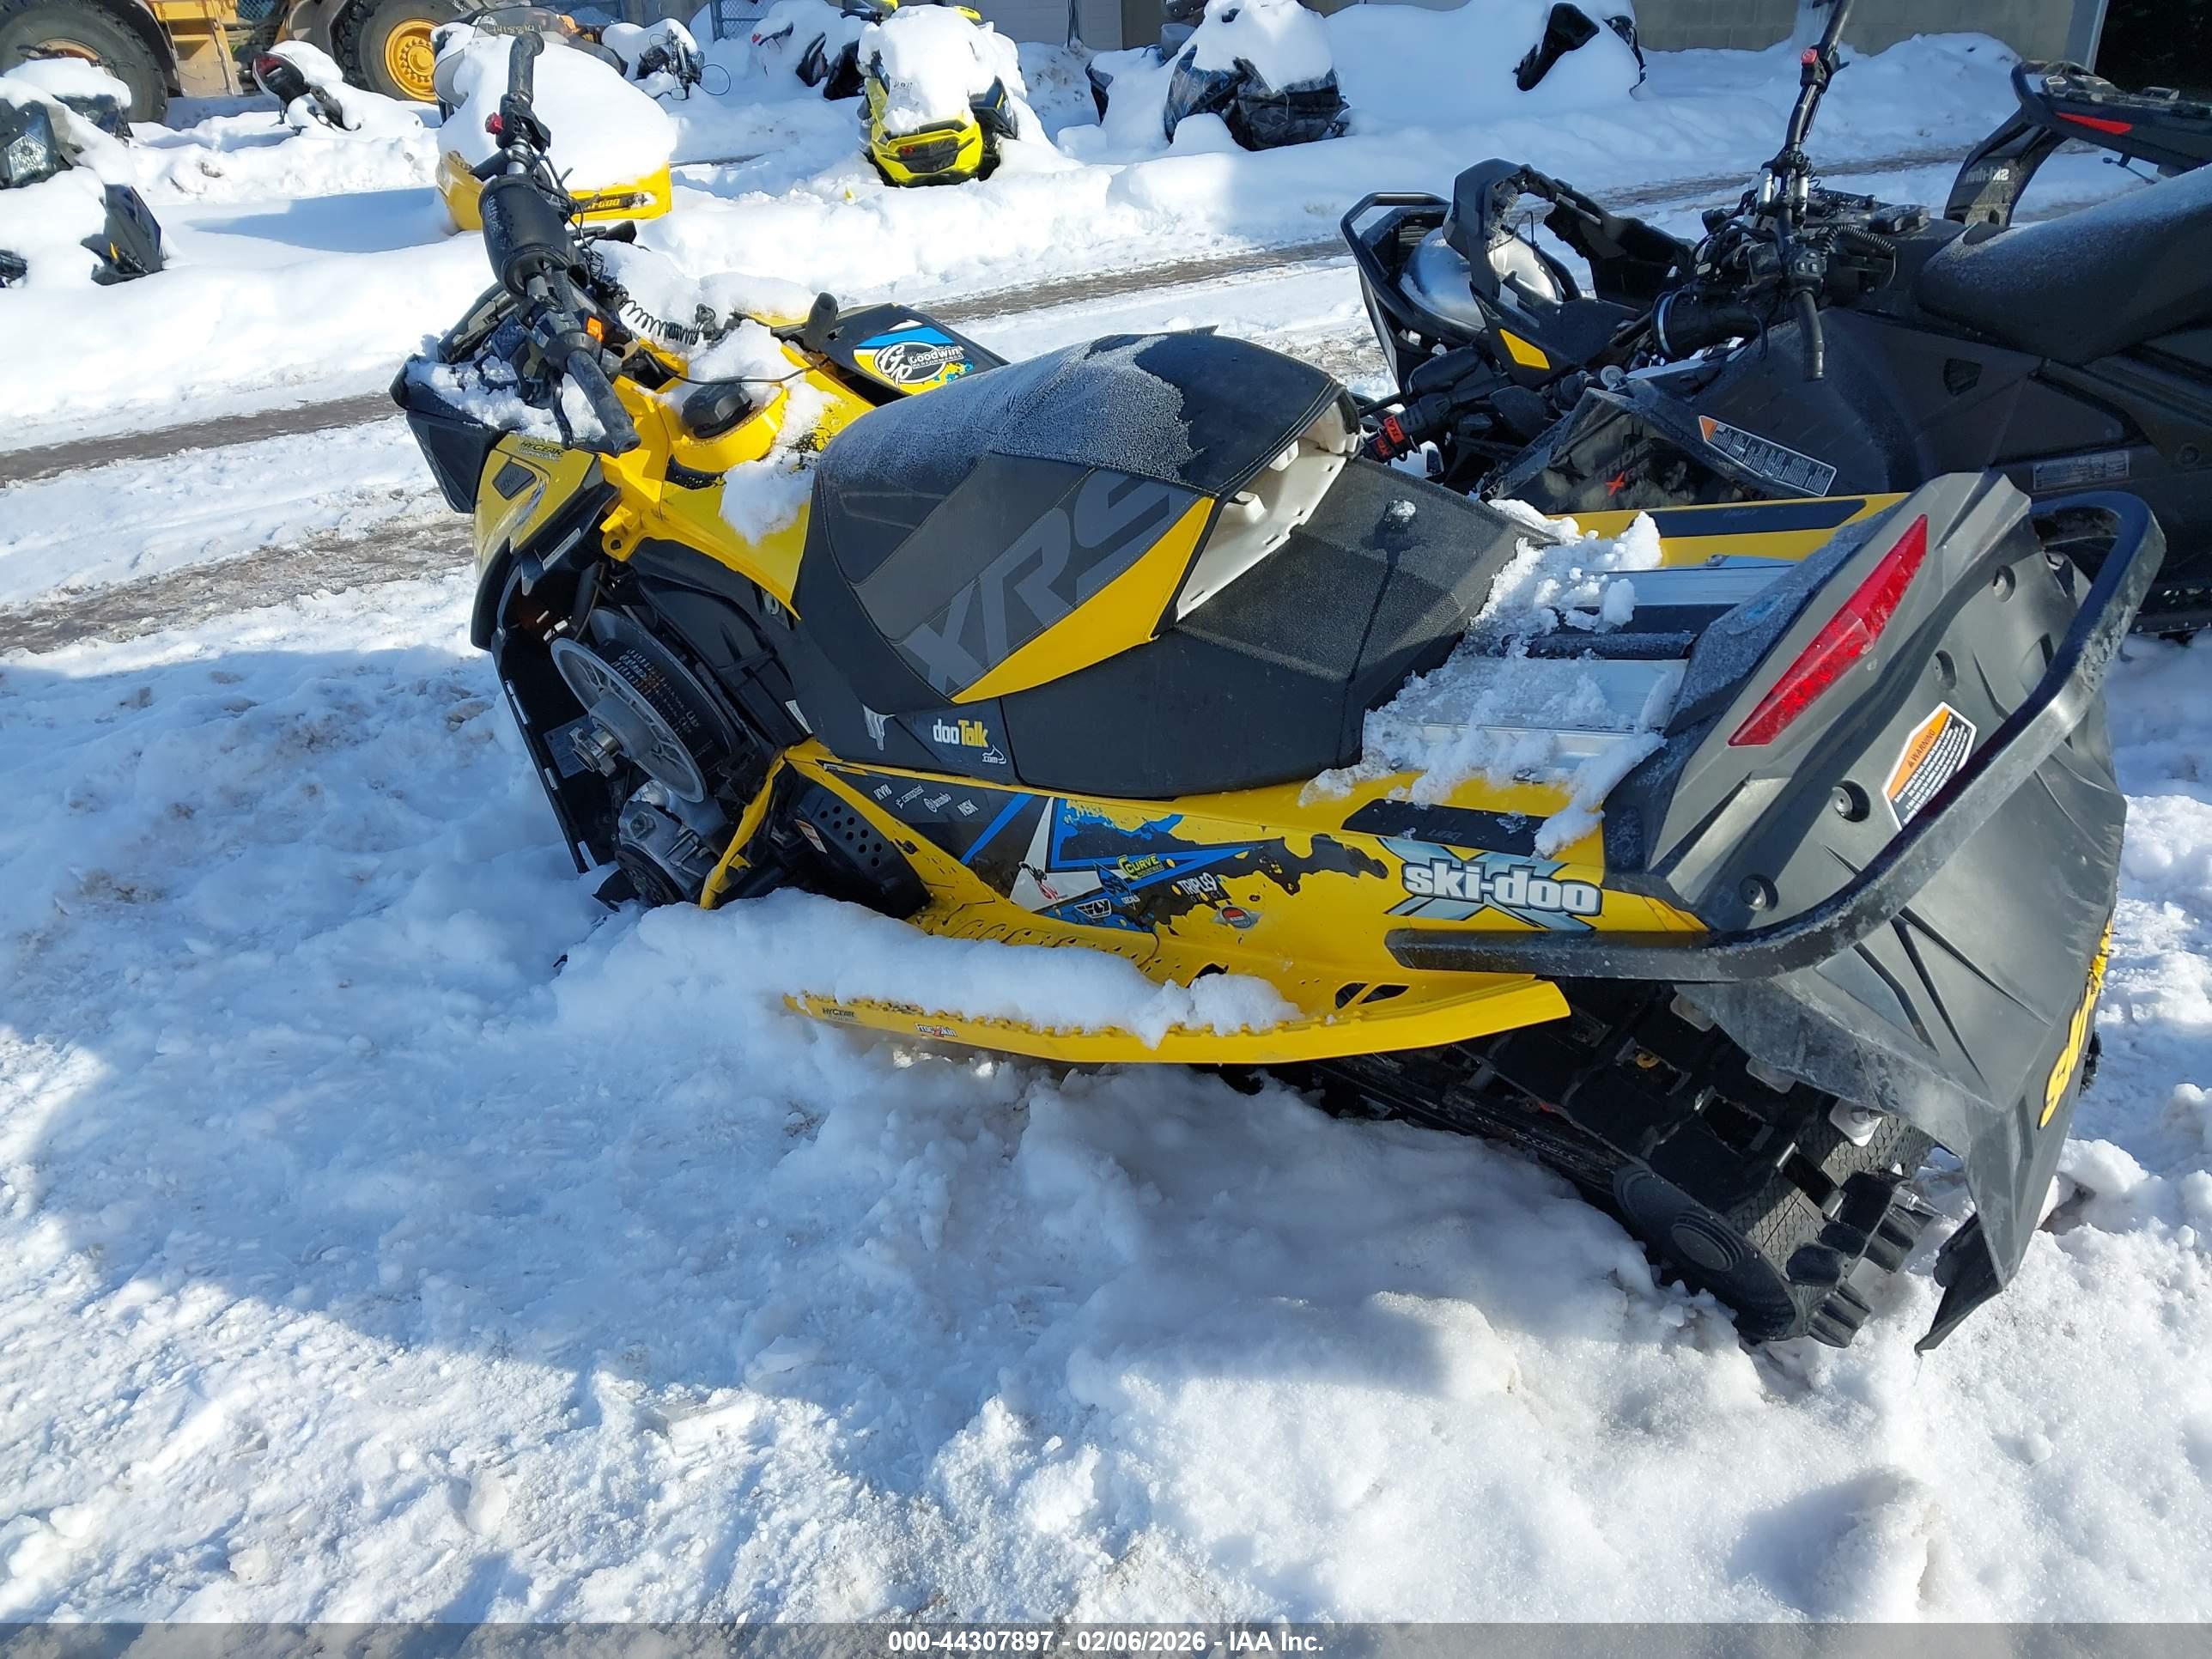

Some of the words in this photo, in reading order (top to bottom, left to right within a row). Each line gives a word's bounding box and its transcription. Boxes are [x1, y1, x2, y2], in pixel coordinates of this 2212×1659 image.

[908, 346, 961, 365] Goodwin
[933, 718, 989, 748] dooTalk
[1911, 729, 1936, 762] WARNING
[957, 799, 979, 817] NSK
[1125, 855, 1160, 873] CURVE
[1403, 860, 1601, 915] ski-doo
